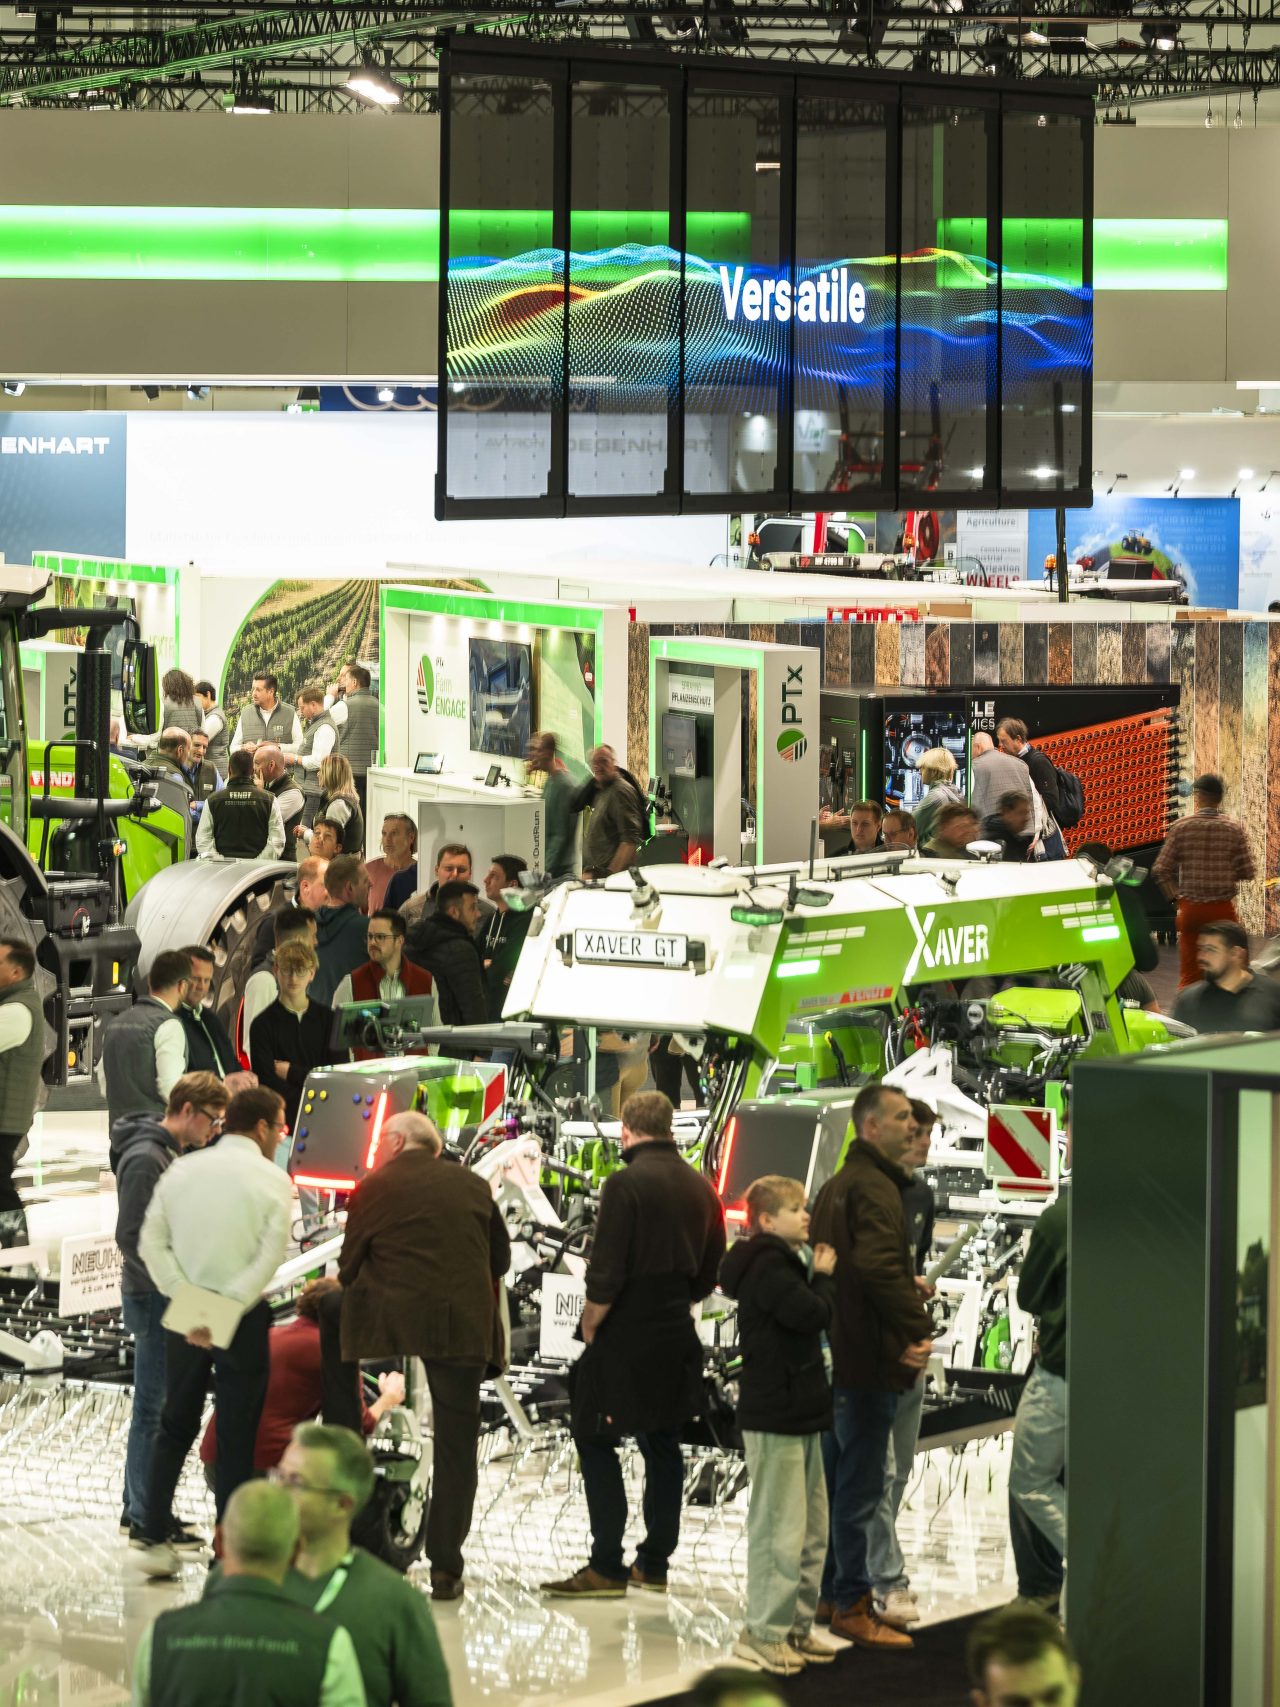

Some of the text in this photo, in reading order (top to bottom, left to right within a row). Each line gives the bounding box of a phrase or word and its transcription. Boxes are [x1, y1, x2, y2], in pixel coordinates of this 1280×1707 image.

[719, 265, 866, 324] Versatile
[966, 516, 1017, 528] Agriculture
[782, 664, 803, 725] PTx
[435, 696, 467, 719] ENGAGE
[971, 700, 996, 718] LE
[31, 770, 75, 787] FND
[229, 791, 253, 799] FENDT
[584, 933, 678, 958] XAVER GT
[901, 904, 989, 986] XAVER
[72, 1248, 123, 1275] NEUH
